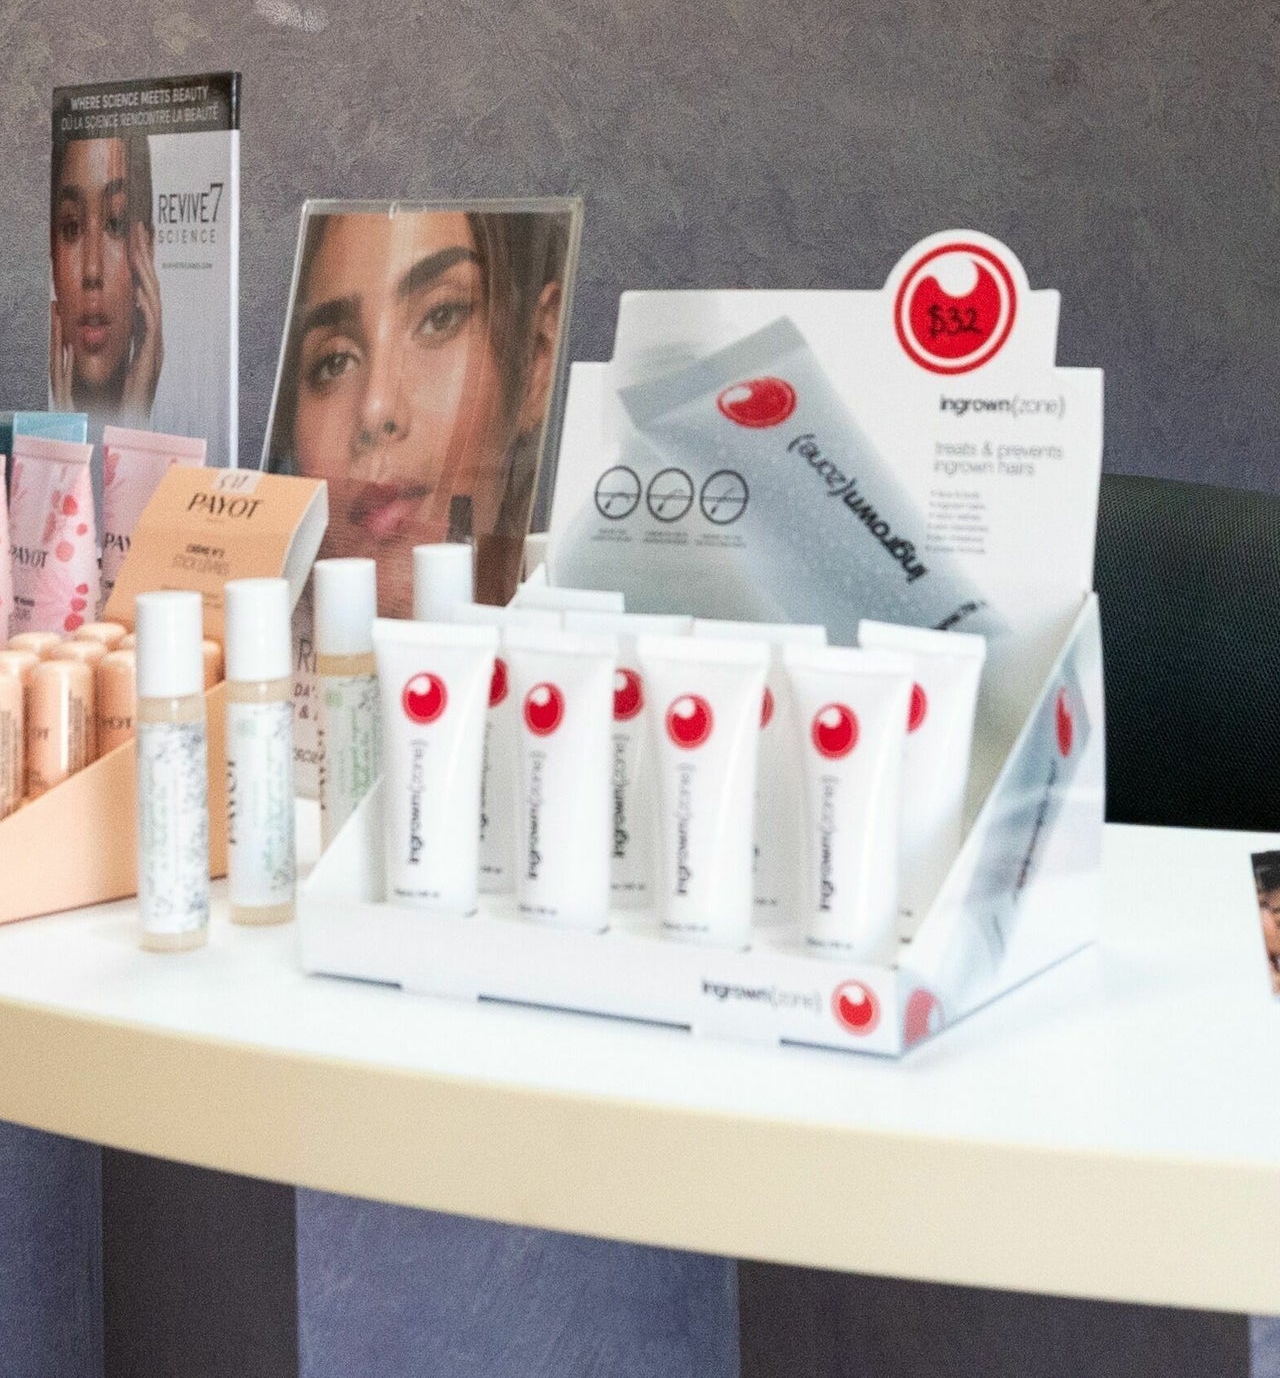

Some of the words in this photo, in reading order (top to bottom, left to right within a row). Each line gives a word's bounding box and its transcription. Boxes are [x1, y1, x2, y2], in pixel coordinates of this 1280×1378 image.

[71, 97, 102, 111] WHERE
[102, 92, 140, 108] SCIENCE
[141, 90, 171, 105] MEETS
[173, 86, 209, 102] BEAUTY
[85, 112, 119, 129] SCIENCE
[158, 229, 216, 244] SCIENCE
[927, 302, 984, 339] $32
[940, 393, 1066, 420] ingrown(zone)
[934, 441, 977, 456] treats
[982, 440, 993, 456] &
[997, 444, 1064, 460] prevents
[934, 459, 994, 475] ingrown
[997, 460, 1035, 476] hairs
[187, 492, 263, 519] PAYOT
[9, 545, 49, 569] PAYOT
